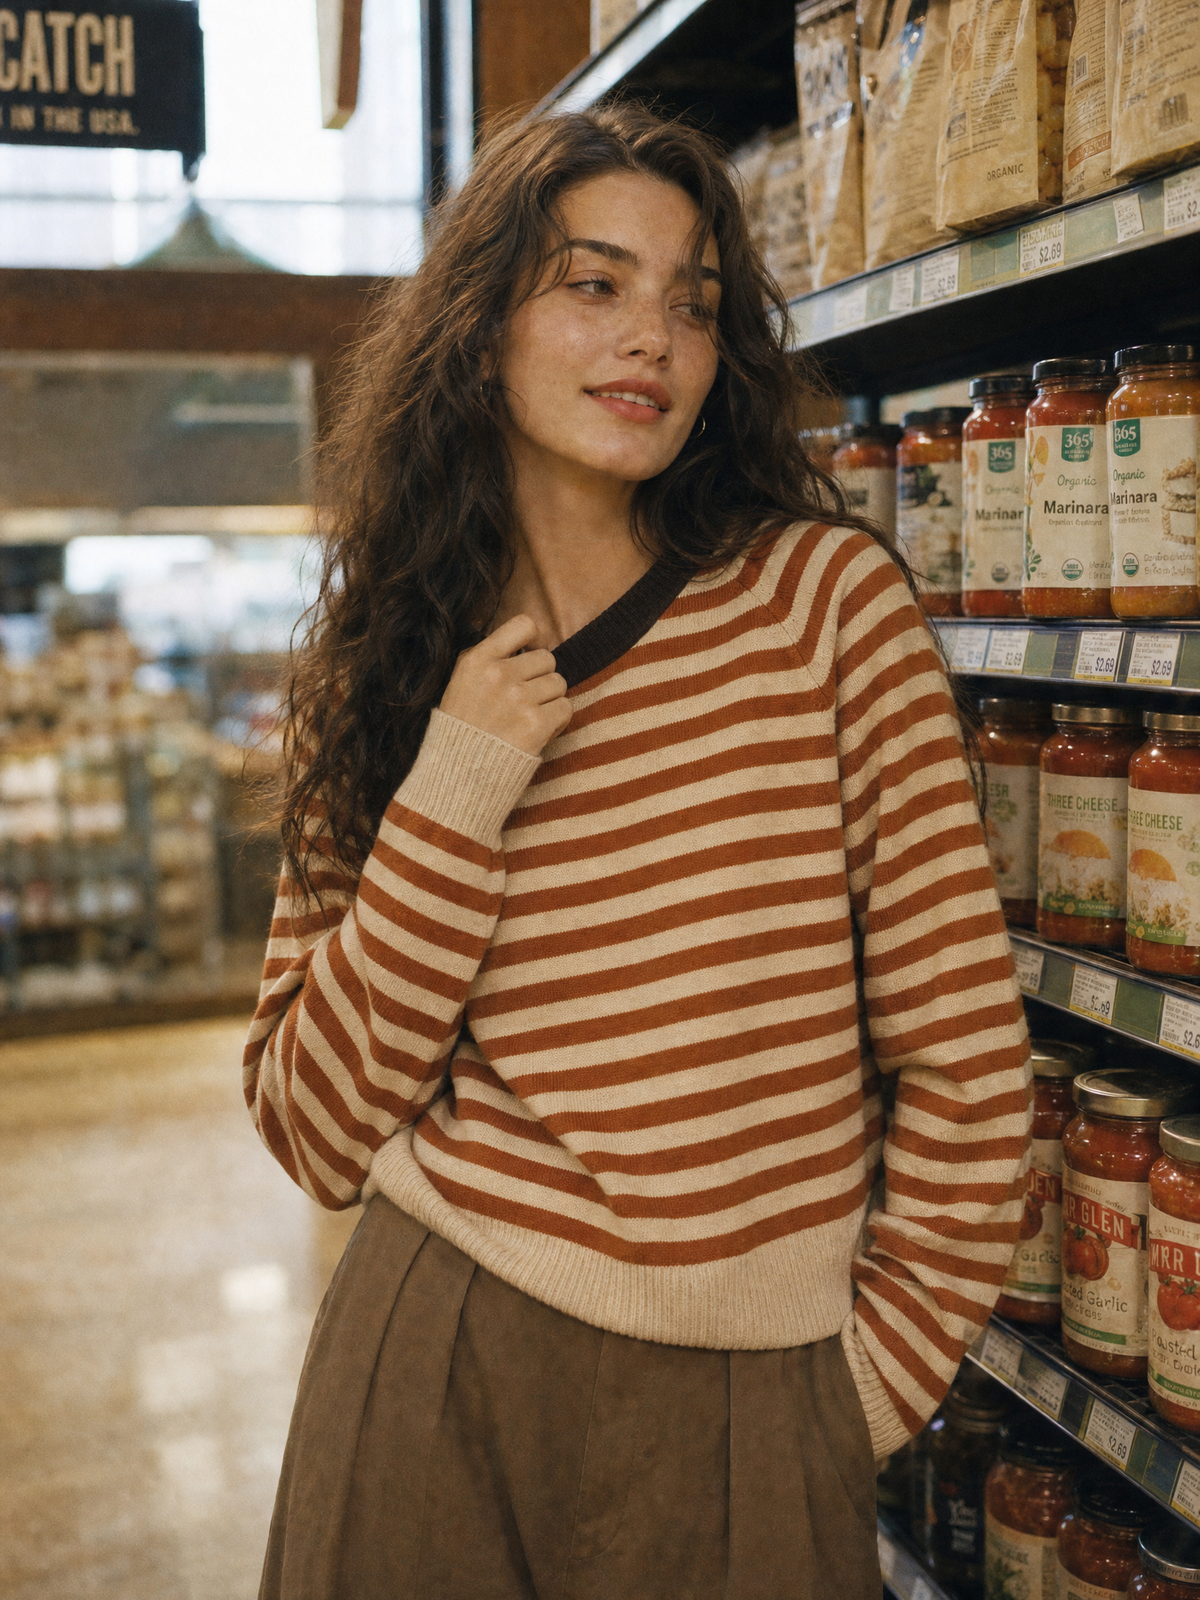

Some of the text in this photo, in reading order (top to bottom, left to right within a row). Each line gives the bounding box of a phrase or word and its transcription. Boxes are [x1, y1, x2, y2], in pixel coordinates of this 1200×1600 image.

[0, 8, 136, 97] CATCH
[10, 104, 36, 132] IN
[41, 105, 84, 134] THE
[986, 163, 1024, 182] ORGANIC
[1039, 242, 1062, 264] $2.69
[1064, 431, 1090, 448] 365
[990, 444, 1013, 460] 365
[1057, 474, 1097, 490] Organic
[1112, 469, 1146, 485] Organic
[1043, 500, 1109, 514] Marinara
[1110, 490, 1158, 506] Marinara
[975, 507, 1024, 521] Marinar
[1095, 657, 1115, 673] $2.69
[1150, 660, 1173, 676] $2.69
[1047, 792, 1118, 812] THREE CHEESE
[1144, 812, 1183, 831] CHEESE
[1182, 1029, 1200, 1049] $2.6
[1081, 1201, 1124, 1240] GLEN
[1086, 1291, 1128, 1313] Garlic
[1108, 1435, 1127, 1459] $2.69
